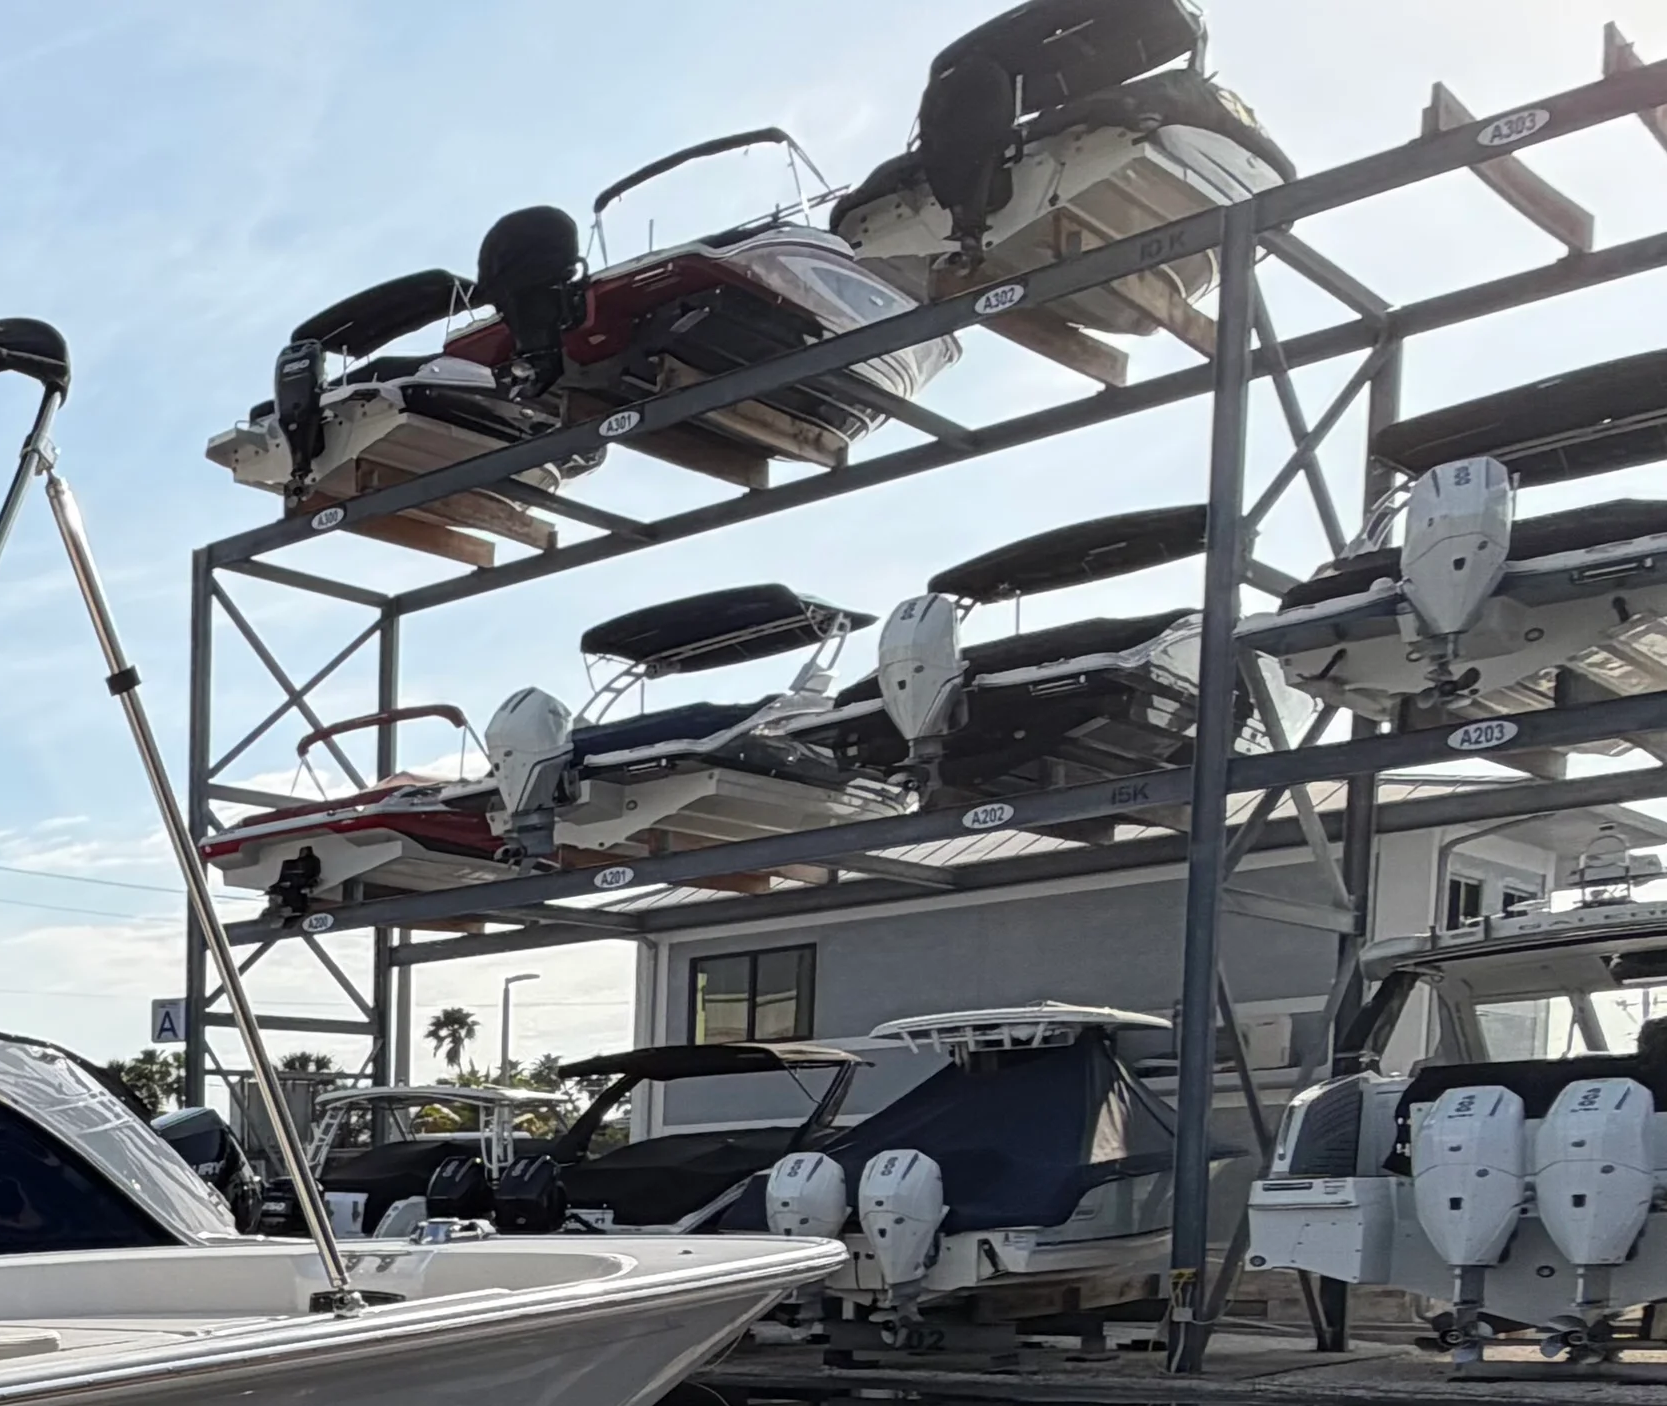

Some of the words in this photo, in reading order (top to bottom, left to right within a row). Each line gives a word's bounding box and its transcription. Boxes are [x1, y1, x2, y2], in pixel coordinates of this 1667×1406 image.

[1489, 113, 1536, 143] A303
[983, 287, 1017, 311] A302
[603, 415, 632, 434] A301
[317, 511, 339, 527] A300
[1460, 723, 1505, 747] A203
[1111, 782, 1150, 805] 15K
[970, 806, 1005, 826] A202
[600, 870, 626, 886] A201
[307, 914, 328, 930] A200
[157, 1010, 179, 1040] A
